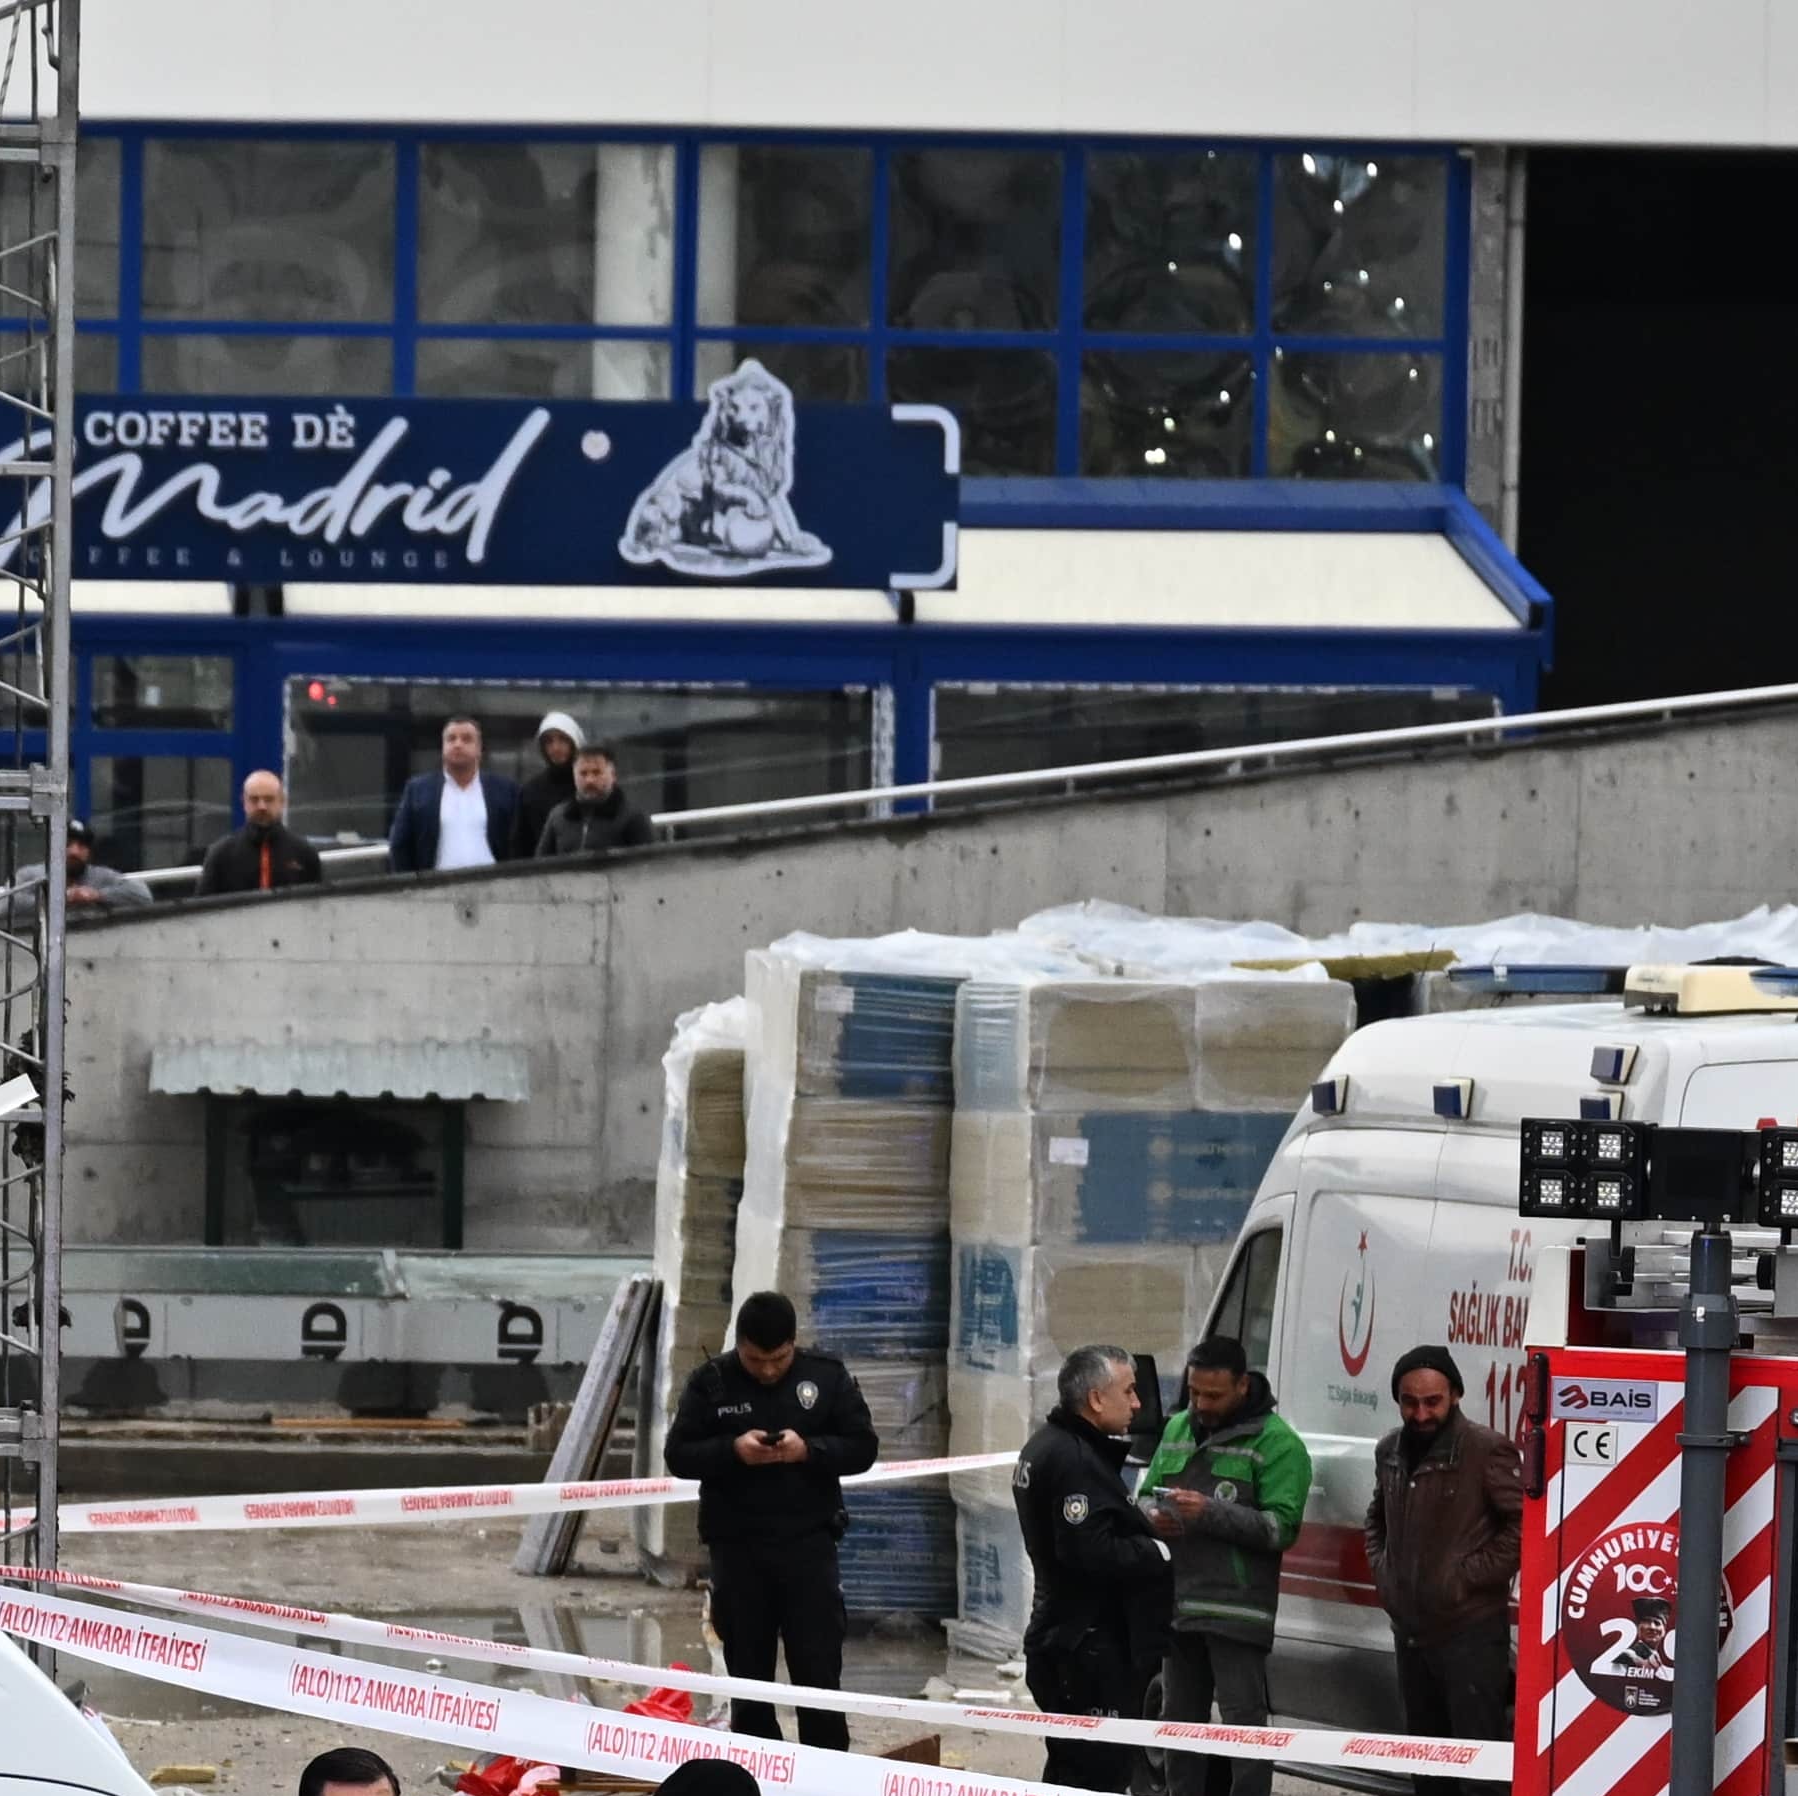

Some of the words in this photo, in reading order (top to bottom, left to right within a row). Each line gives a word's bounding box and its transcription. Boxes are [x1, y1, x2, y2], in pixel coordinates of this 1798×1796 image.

[84, 412, 268, 447] COFFEE
[293, 404, 355, 448] DÈ
[29, 548, 190, 567] CFFEE
[225, 548, 243, 568] &
[280, 549, 448, 569] LOUNGE
[1448, 1280, 1502, 1346] SAĞLIK
[67, 1616, 132, 1657] ANKARA
[134, 1626, 207, 1673] İTFAİYESİ
[362, 1680, 426, 1717] ANKARA
[429, 1686, 501, 1733] İTFAİYESİ
